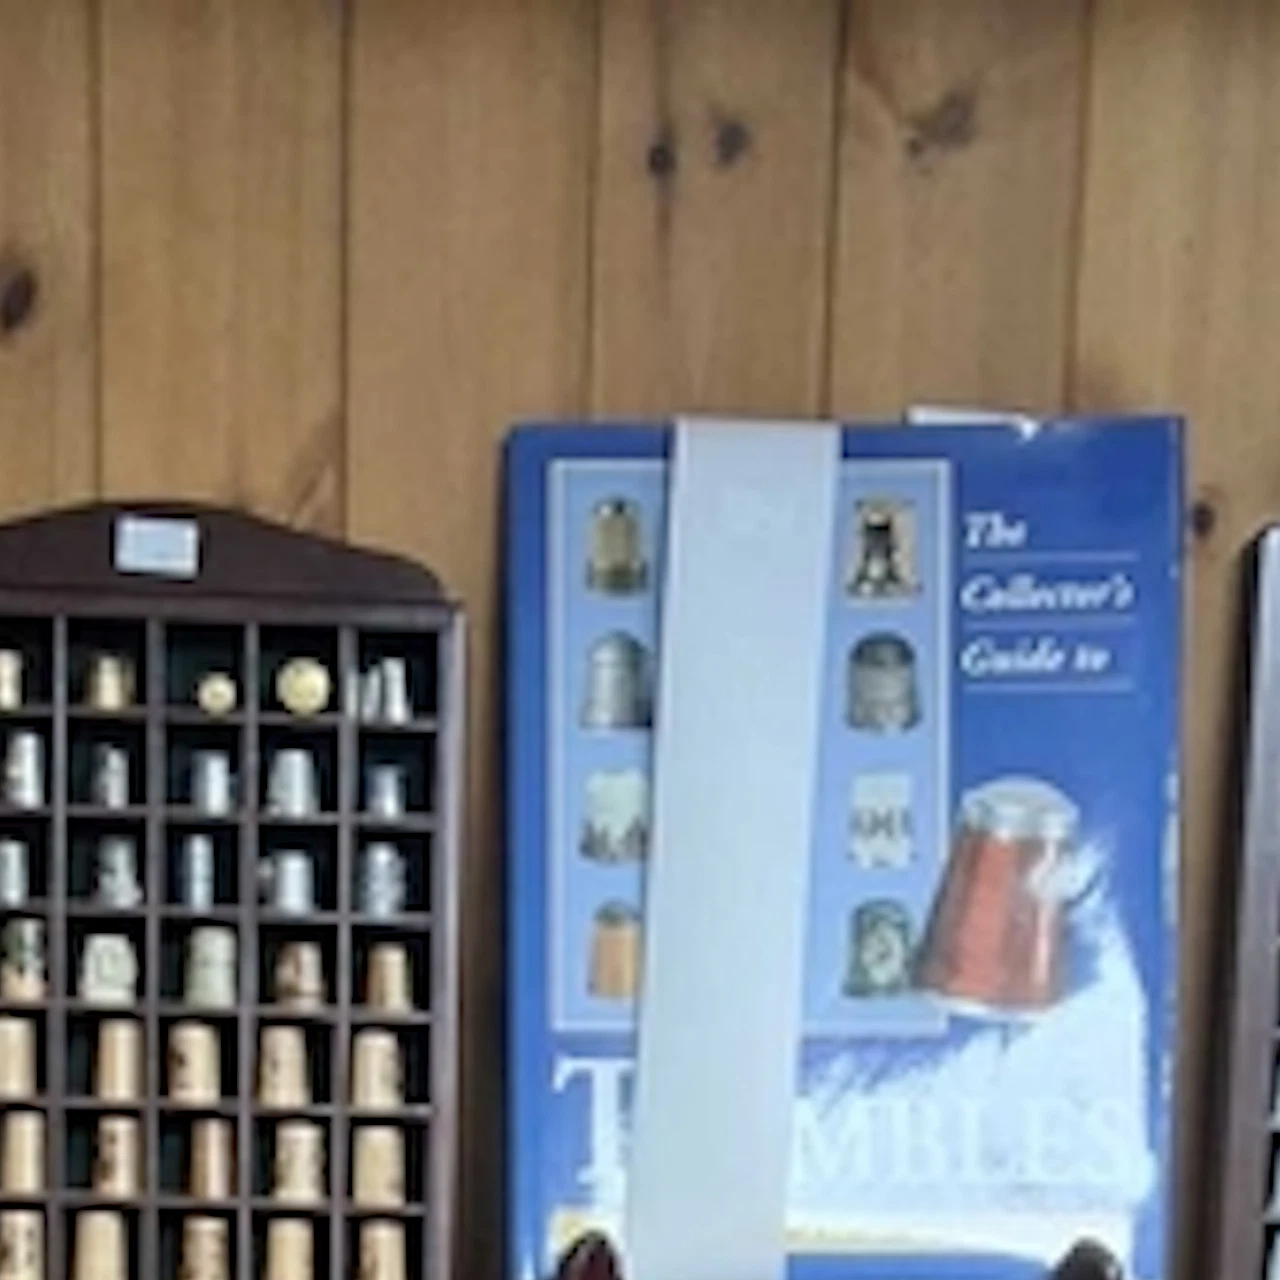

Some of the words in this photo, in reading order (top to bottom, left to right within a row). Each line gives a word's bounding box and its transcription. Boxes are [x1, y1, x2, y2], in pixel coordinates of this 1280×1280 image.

[965, 511, 1028, 547] The
[960, 635, 1066, 676] Guide
[1073, 645, 1112, 672] to
[552, 1056, 1130, 1186] TMBLES
